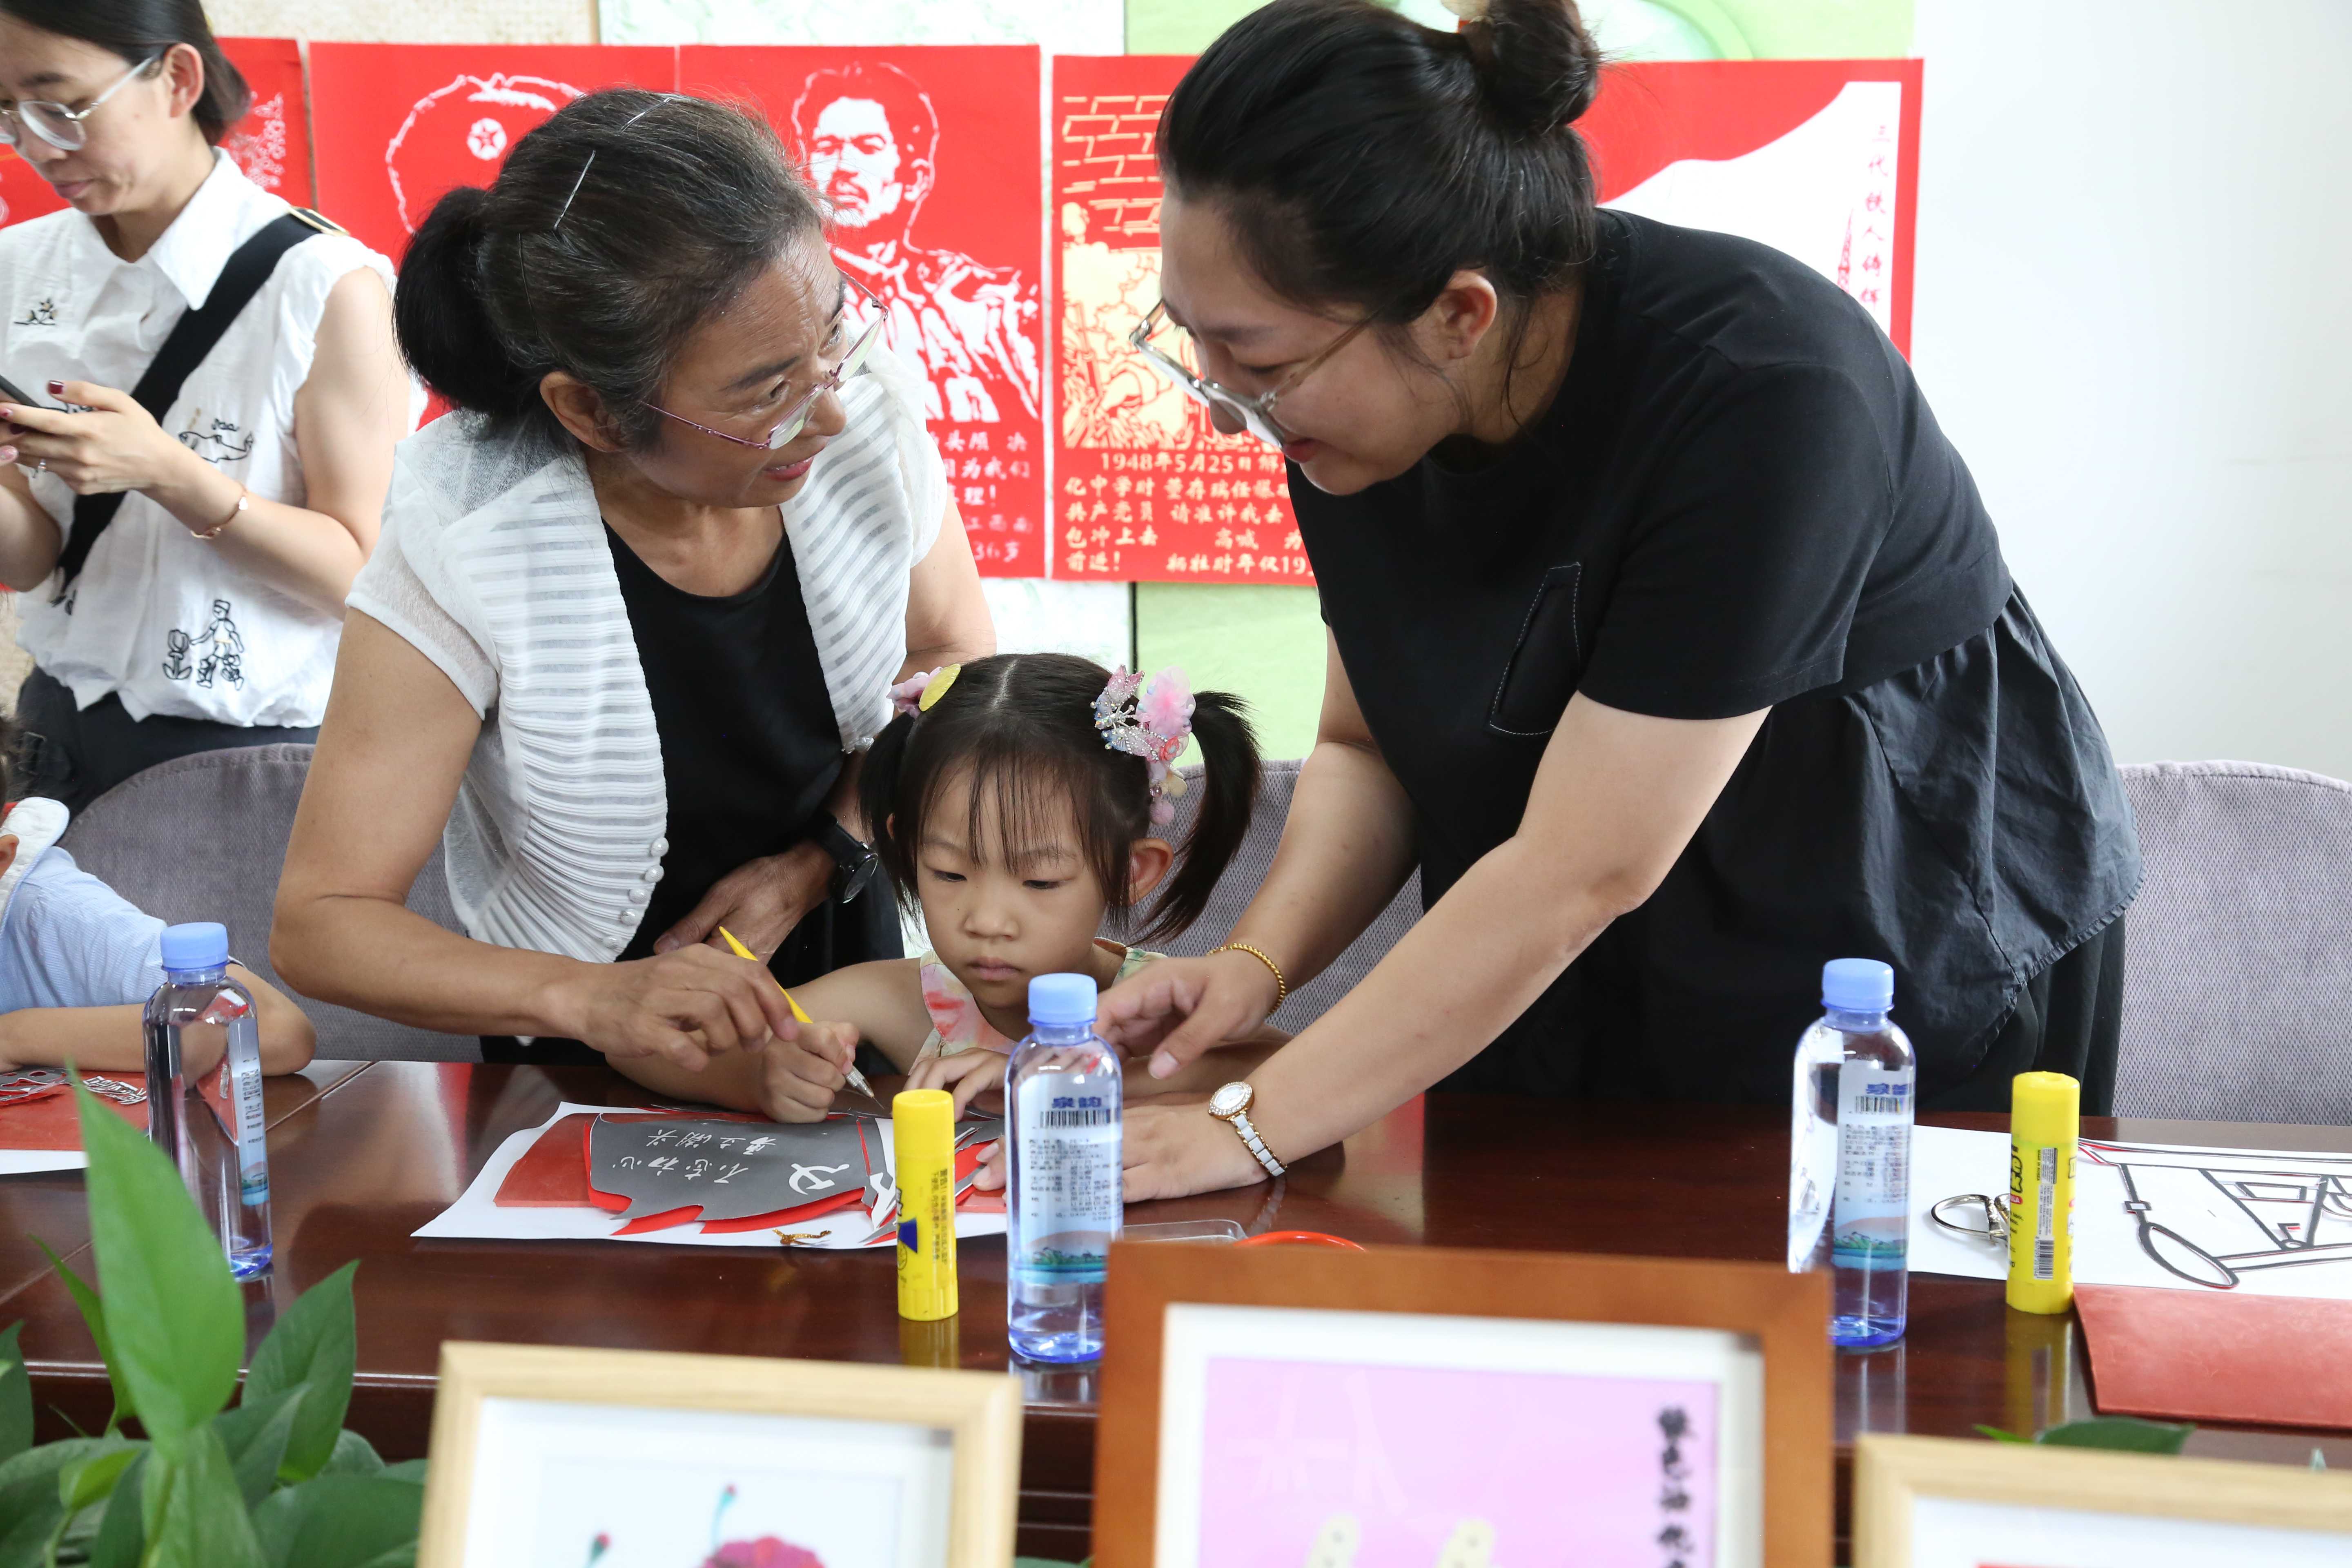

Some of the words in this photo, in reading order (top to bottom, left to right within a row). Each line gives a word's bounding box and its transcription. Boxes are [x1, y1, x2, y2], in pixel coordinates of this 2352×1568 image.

[1101, 452, 1287, 474] 1948年5月25日解
[1166, 552, 1314, 577] 牺牲时年仅19
[612, 1156, 748, 1183] 不忘初心
